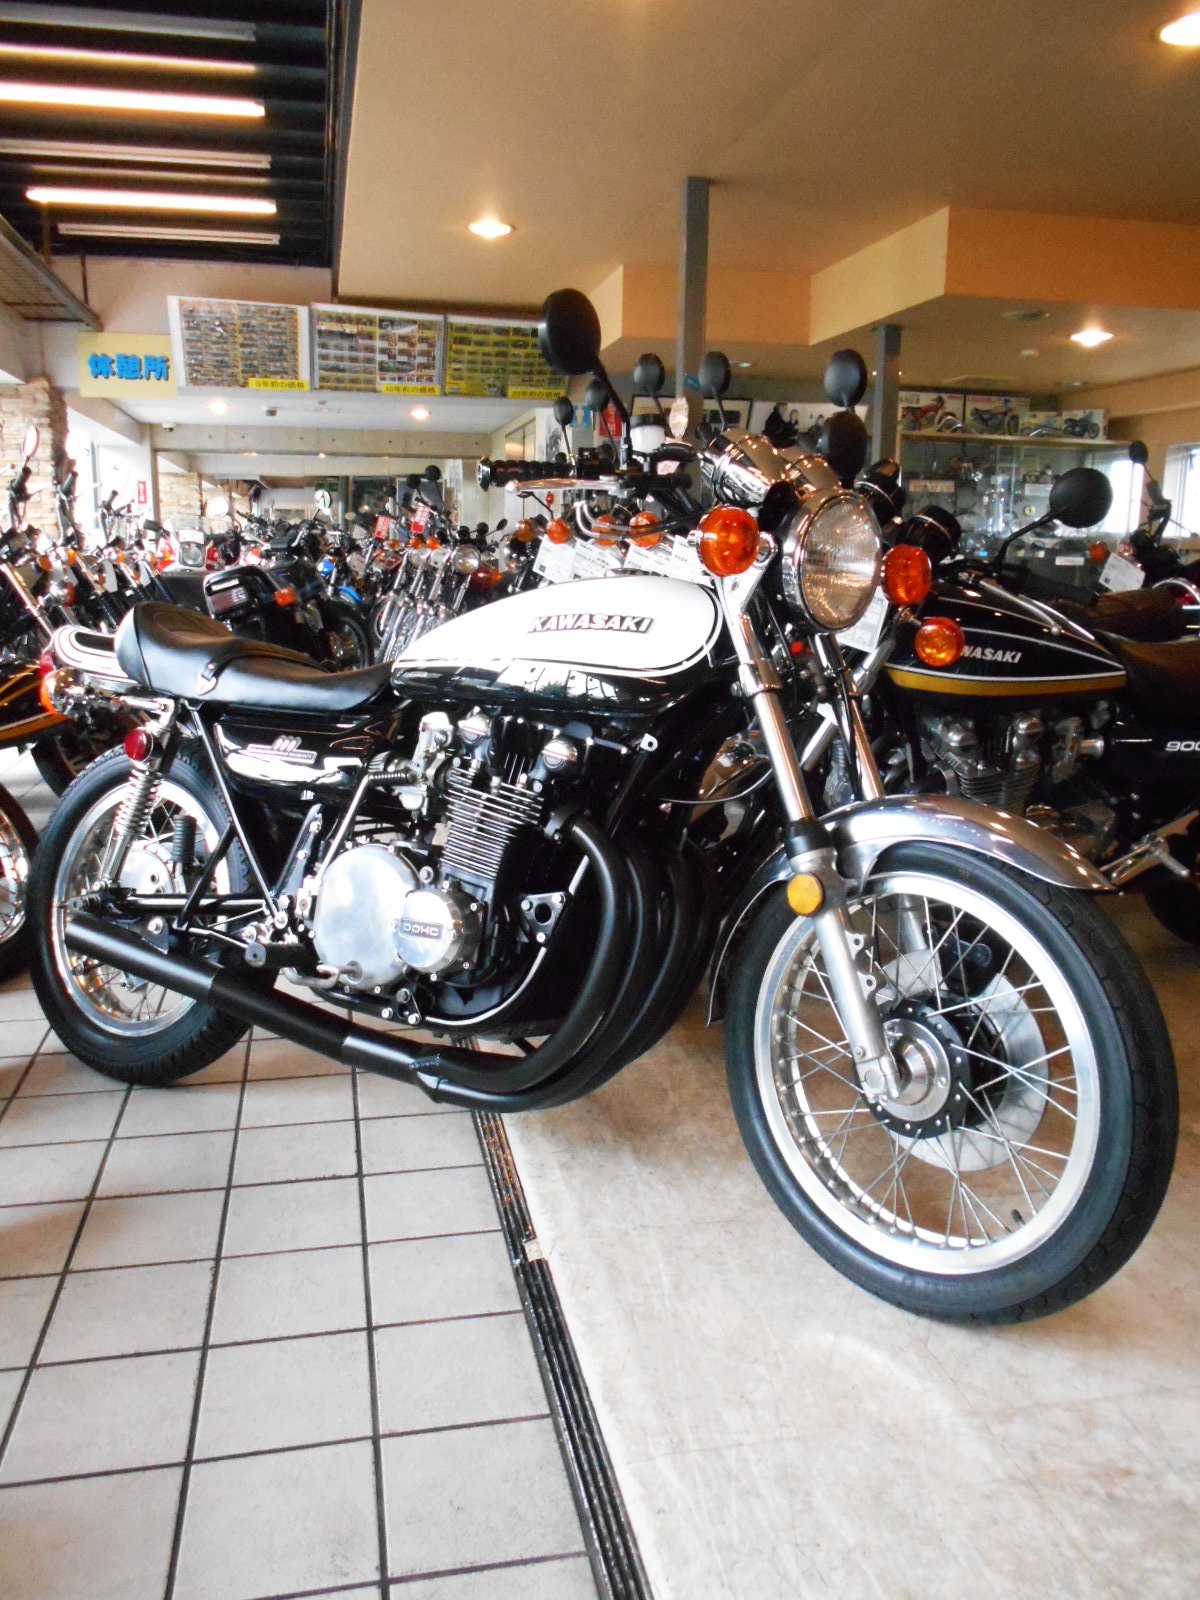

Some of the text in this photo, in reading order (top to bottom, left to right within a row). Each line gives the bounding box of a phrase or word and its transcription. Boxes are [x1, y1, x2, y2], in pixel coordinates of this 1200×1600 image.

[528, 613, 653, 633] KAWASAKI
[960, 645, 1022, 664] WASAKI
[403, 922, 440, 937] DOHC
